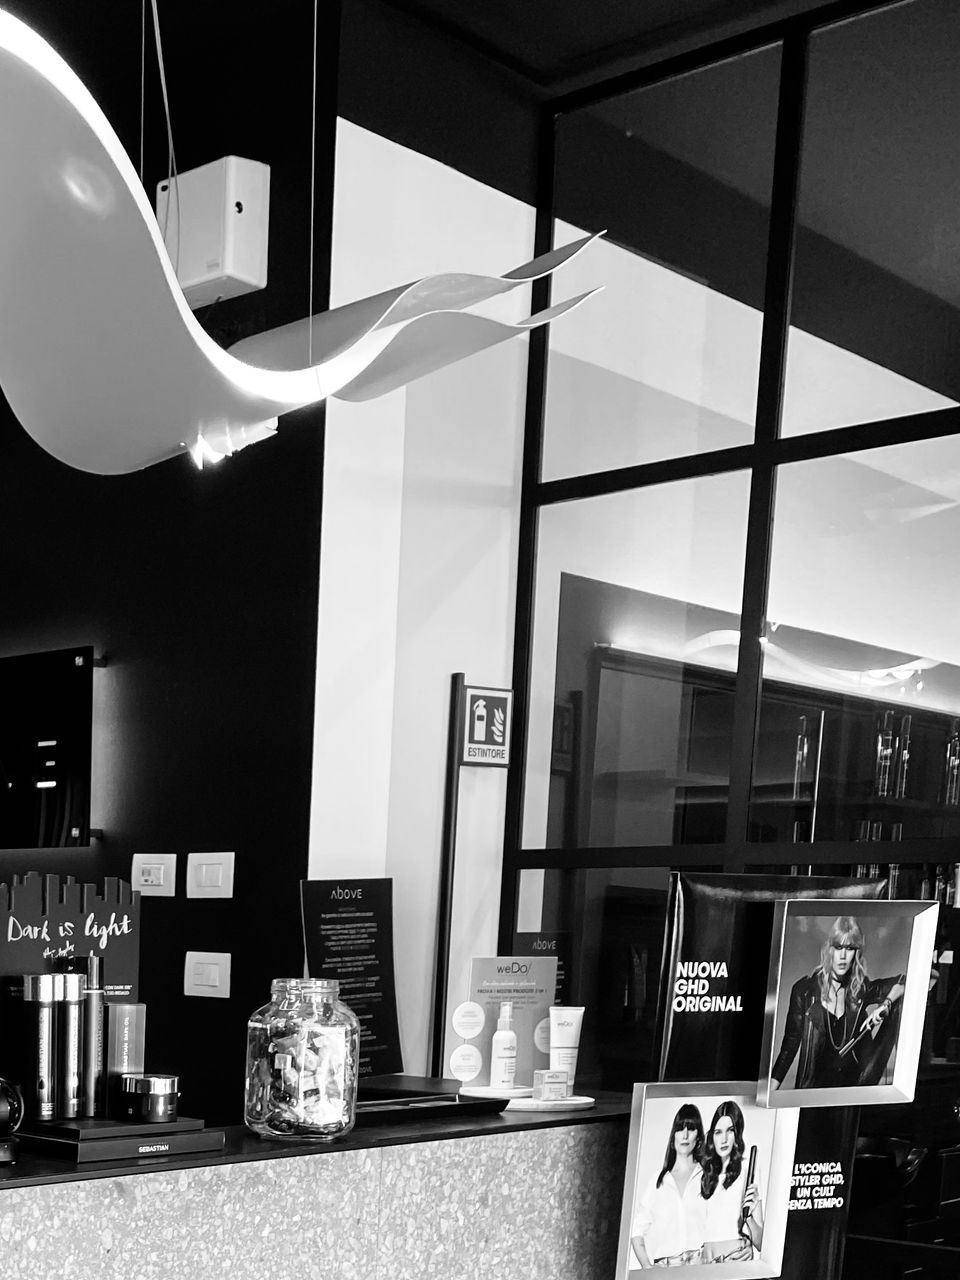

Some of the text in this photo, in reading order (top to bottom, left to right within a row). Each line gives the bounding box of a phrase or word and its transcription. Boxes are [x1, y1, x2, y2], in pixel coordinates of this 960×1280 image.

[467, 746, 506, 759] ESTINTORE
[7, 915, 51, 942] Dark
[58, 921, 75, 937] is
[84, 912, 133, 949] light
[675, 961, 729, 979] NUOVA
[674, 979, 710, 995] GHD
[672, 995, 743, 1013] ORIGINAL
[138, 1144, 169, 1153] SEBASTIAN
[794, 1162, 842, 1175] L'ICONICA
[821, 1174, 845, 1185] GHD,
[796, 1186, 836, 1198] UN CULT
[813, 1197, 844, 1209] TEMPO
